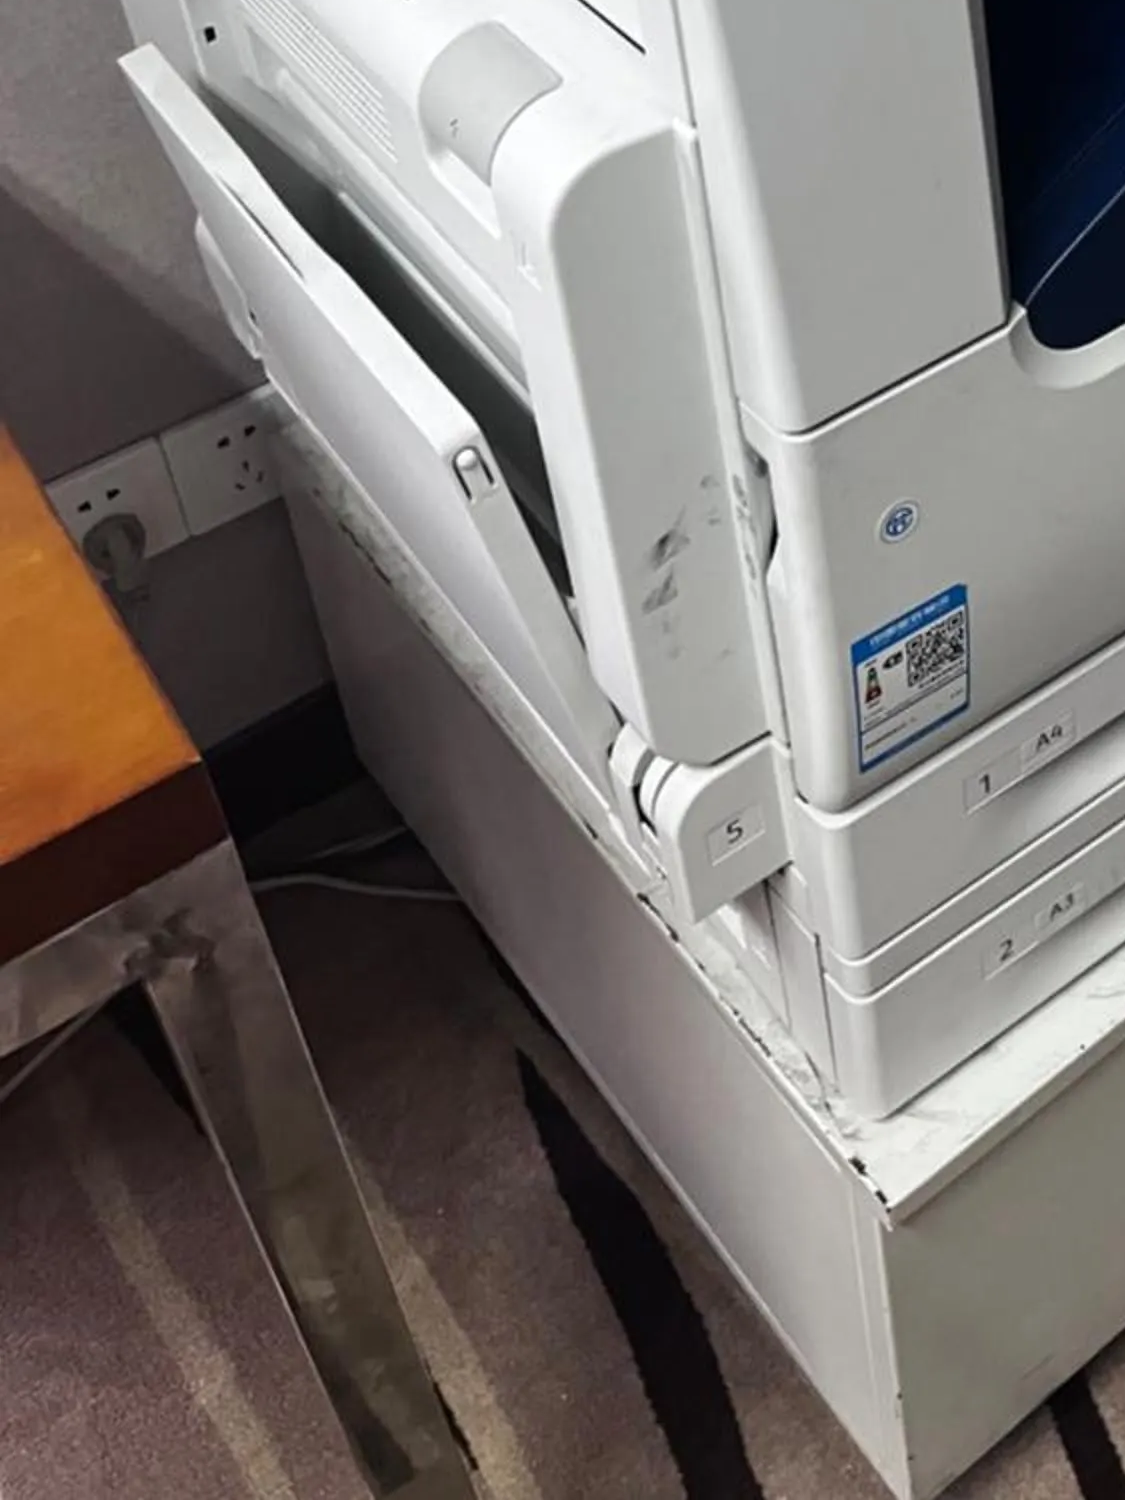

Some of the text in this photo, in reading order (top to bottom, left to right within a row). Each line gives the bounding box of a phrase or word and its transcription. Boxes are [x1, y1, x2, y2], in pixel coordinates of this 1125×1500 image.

[978, 722, 1064, 795] 1 A4
[998, 938, 1015, 962] 2
